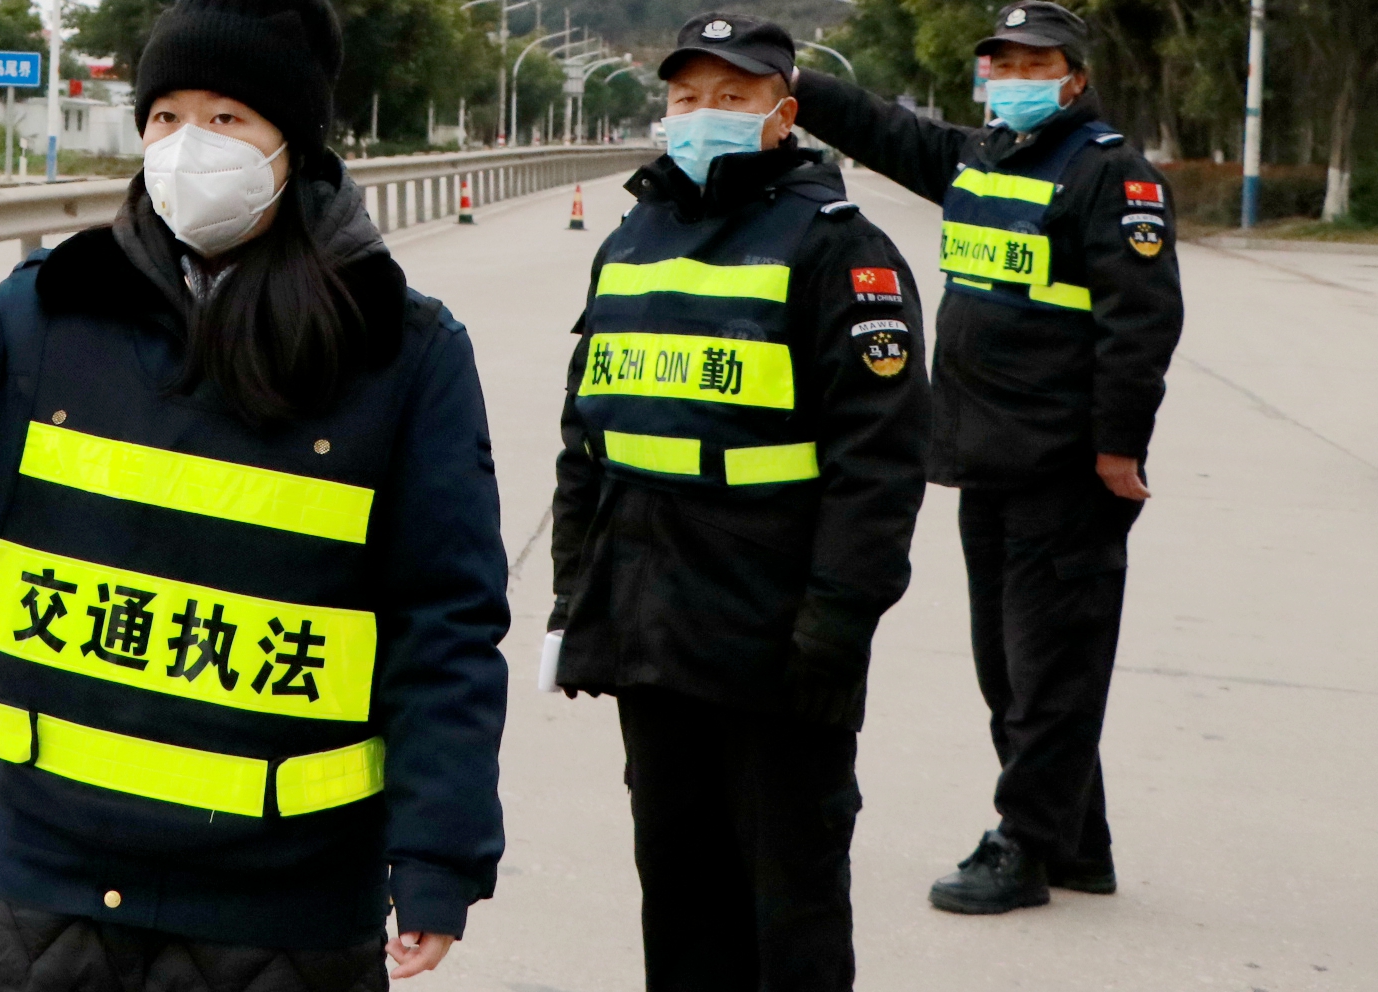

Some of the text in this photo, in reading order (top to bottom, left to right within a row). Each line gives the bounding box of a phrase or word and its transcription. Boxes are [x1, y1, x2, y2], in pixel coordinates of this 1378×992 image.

[1003, 240, 1034, 275] 勤
[858, 320, 900, 332] MAWEI
[591, 343, 743, 395] 执 ZHI QIN 勤
[13, 568, 326, 703] 交通执法
